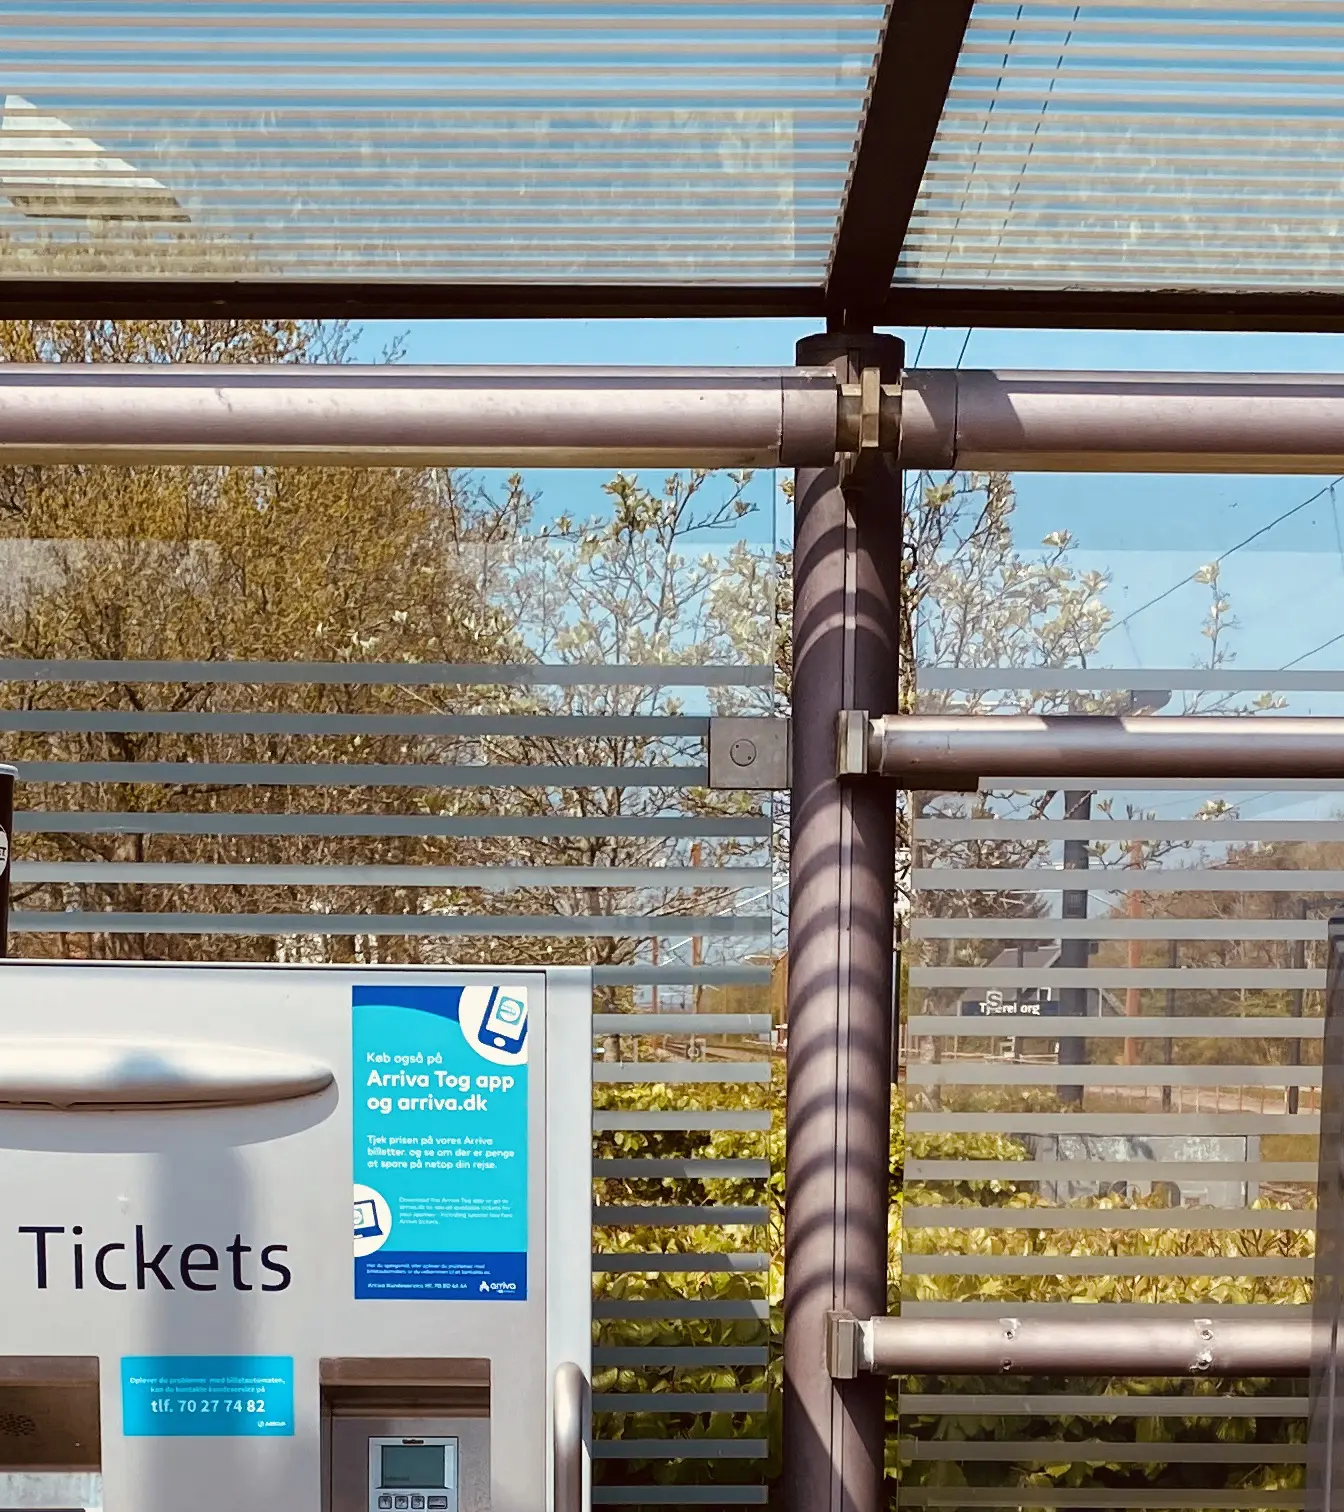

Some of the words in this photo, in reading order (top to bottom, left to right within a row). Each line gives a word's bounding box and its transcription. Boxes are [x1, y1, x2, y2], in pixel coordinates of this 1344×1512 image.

[367, 1052, 391, 1063] Køb
[394, 1051, 423, 1066] også
[427, 1052, 443, 1066] på
[366, 1070, 430, 1087] Arriva
[434, 1070, 471, 1092] Tog
[476, 1074, 515, 1092] app
[367, 1097, 393, 1115] og
[398, 1094, 488, 1111] arriva.dk
[367, 1135, 387, 1146] Tjek
[389, 1135, 419, 1146] prisen
[421, 1135, 434, 1146] på
[436, 1137, 462, 1145] vores
[409, 1149, 422, 1159] og
[424, 1149, 435, 1157] se
[437, 1149, 453, 1157] om
[455, 1147, 471, 1157] der
[473, 1149, 483, 1157] er
[485, 1149, 515, 1160] penge
[367, 1160, 379, 1169] at
[381, 1161, 407, 1171] spare
[410, 1158, 423, 1170] på
[425, 1160, 453, 1170] netop
[455, 1159, 471, 1168] din
[18, 1224, 292, 1291] Tickets
[490, 1281, 517, 1290] arriva
[151, 1398, 174, 1413] tlf.
[177, 1400, 196, 1413] 70
[201, 1400, 220, 1413] 27
[223, 1400, 243, 1413] 74
[246, 1400, 266, 1413] 82
